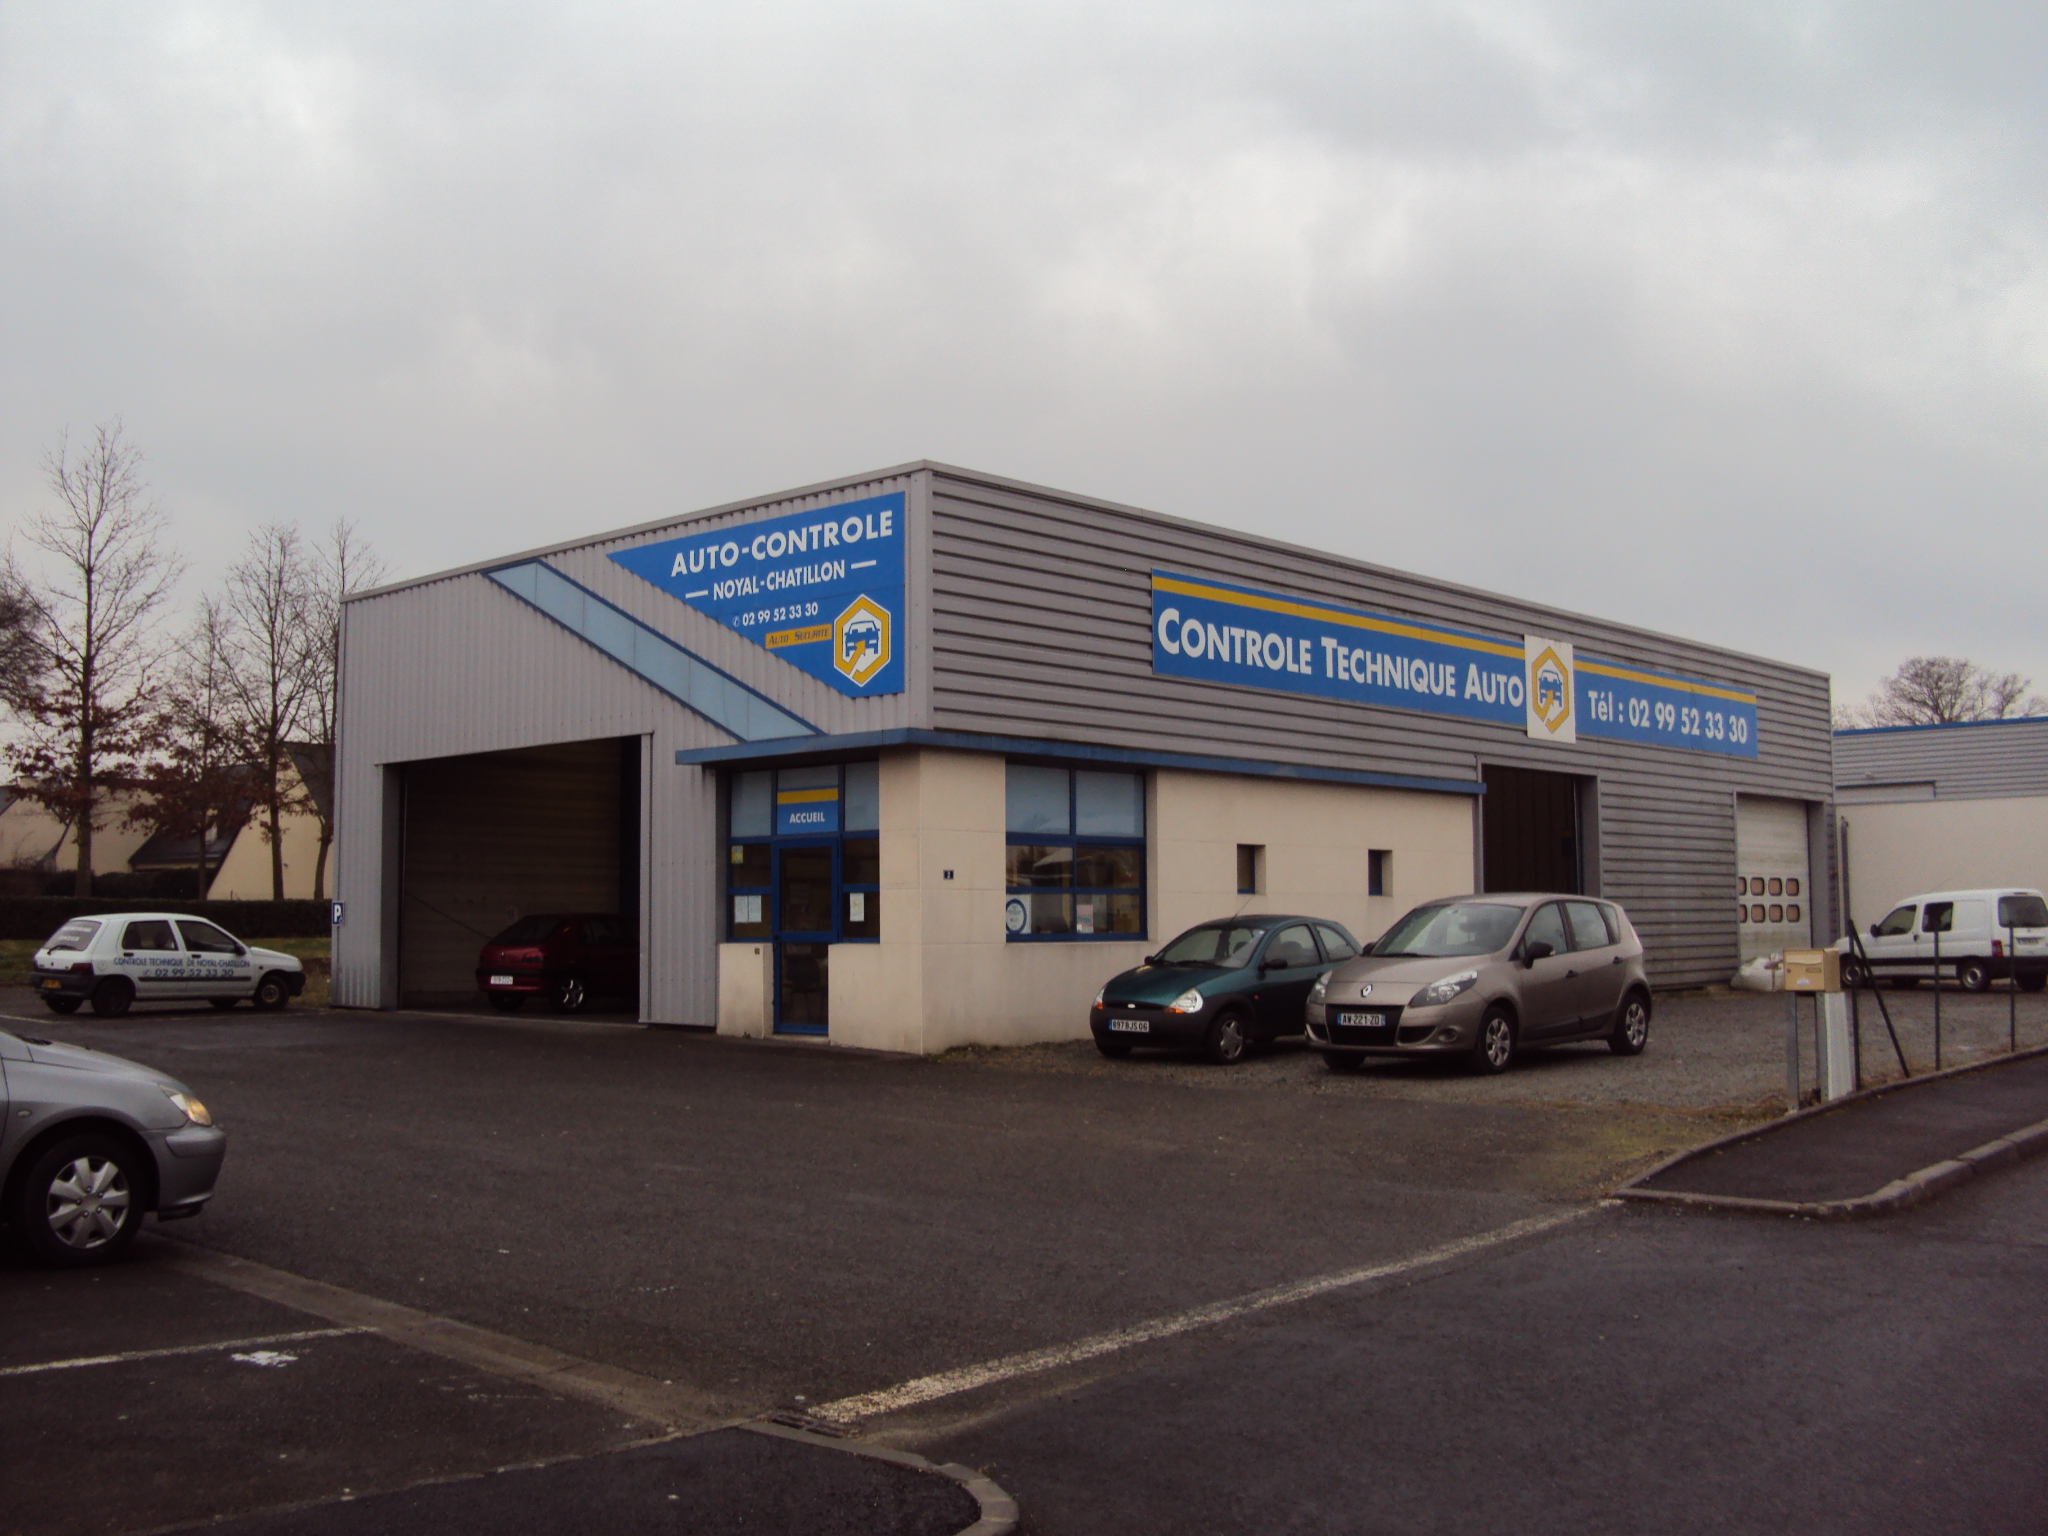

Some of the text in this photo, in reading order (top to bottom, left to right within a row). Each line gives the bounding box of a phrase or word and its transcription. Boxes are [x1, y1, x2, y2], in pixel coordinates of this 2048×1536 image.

[671, 510, 893, 577] AUTO-CONTROLE
[713, 559, 845, 601] NOYAL-CHATILLON
[742, 602, 819, 626] 02 99 52 33 30
[1158, 608, 1524, 708] CONTROLE TECHNIQUE AUTO
[1629, 697, 1650, 727] 02
[1655, 702, 1675, 731] 99
[1681, 707, 1700, 736] 52
[1705, 711, 1724, 740] 33
[1729, 715, 1747, 744] 30
[789, 811, 825, 824] ACCUEIL
[333, 904, 342, 923] P
[155, 968, 234, 977] 02 99 52 33 30
